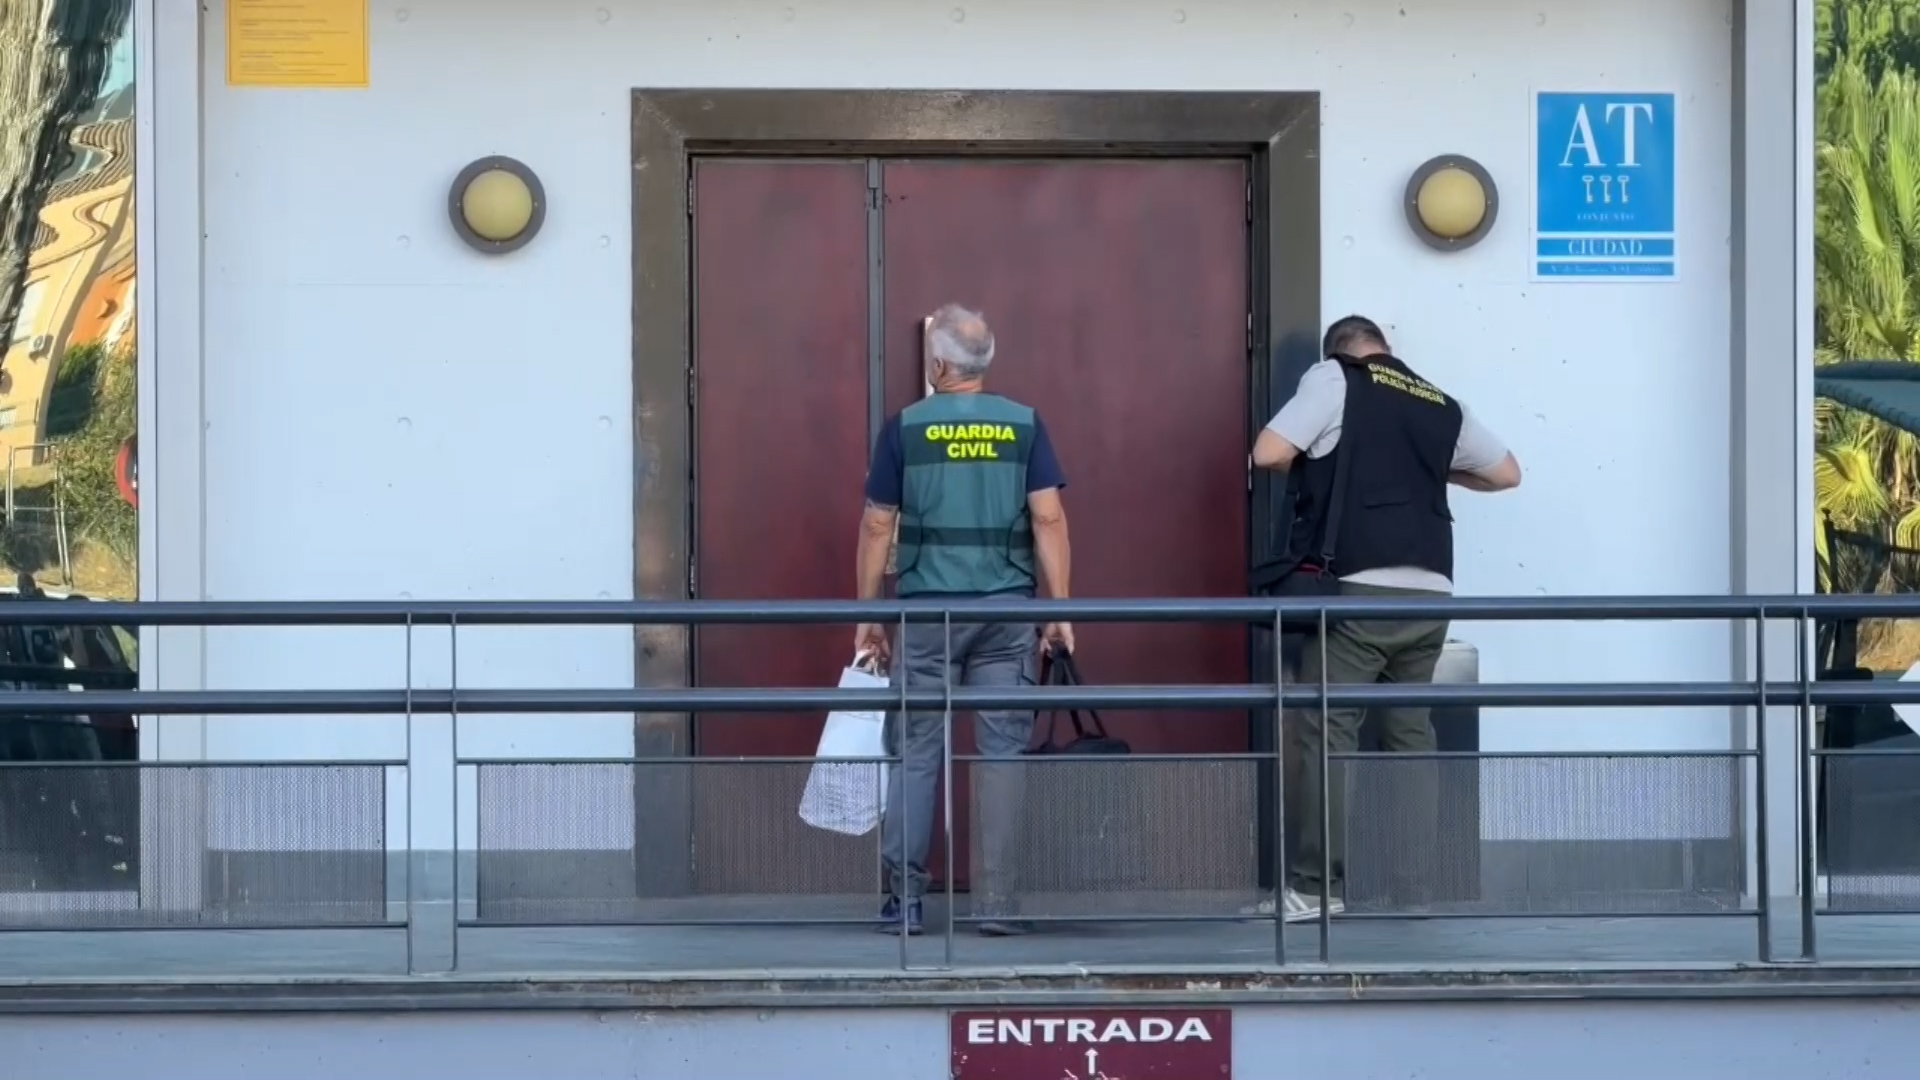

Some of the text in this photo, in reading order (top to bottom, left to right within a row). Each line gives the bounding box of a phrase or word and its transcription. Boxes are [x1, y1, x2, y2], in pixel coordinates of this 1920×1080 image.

[1558, 103, 1653, 167] AT
[1568, 239, 1643, 255] CIUDAD
[925, 424, 1016, 441] GUARDIA
[947, 442, 998, 458] CIVIL
[968, 1017, 1212, 1043] ENTRADA
